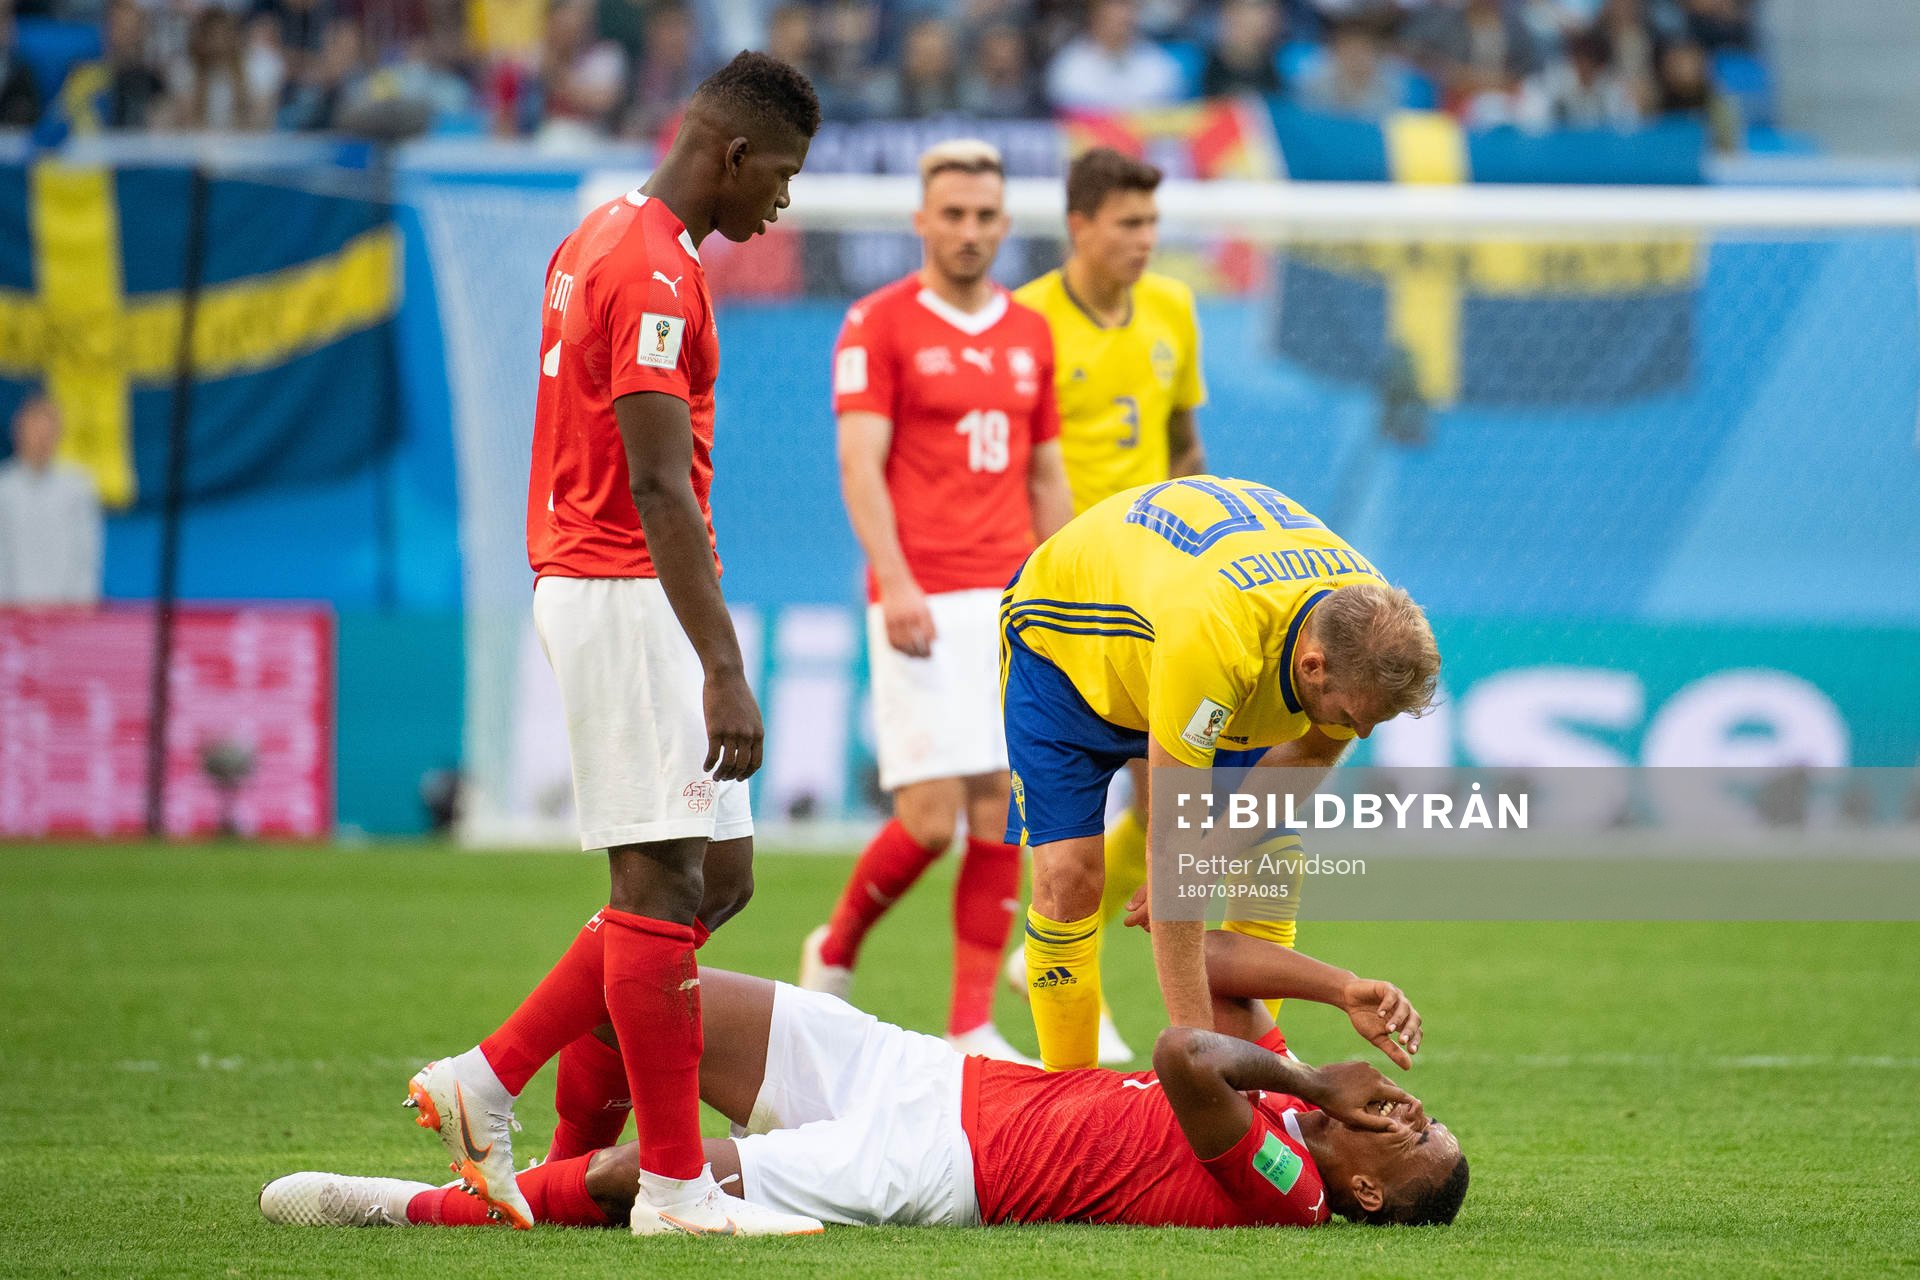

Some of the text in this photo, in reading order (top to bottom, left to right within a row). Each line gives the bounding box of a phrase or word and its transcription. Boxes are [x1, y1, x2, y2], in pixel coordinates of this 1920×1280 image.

[957, 409, 1010, 473] 19
[1114, 396, 1141, 449] 3
[1218, 548, 1388, 591] OIVONEN
[1033, 977, 1077, 987] adidas
